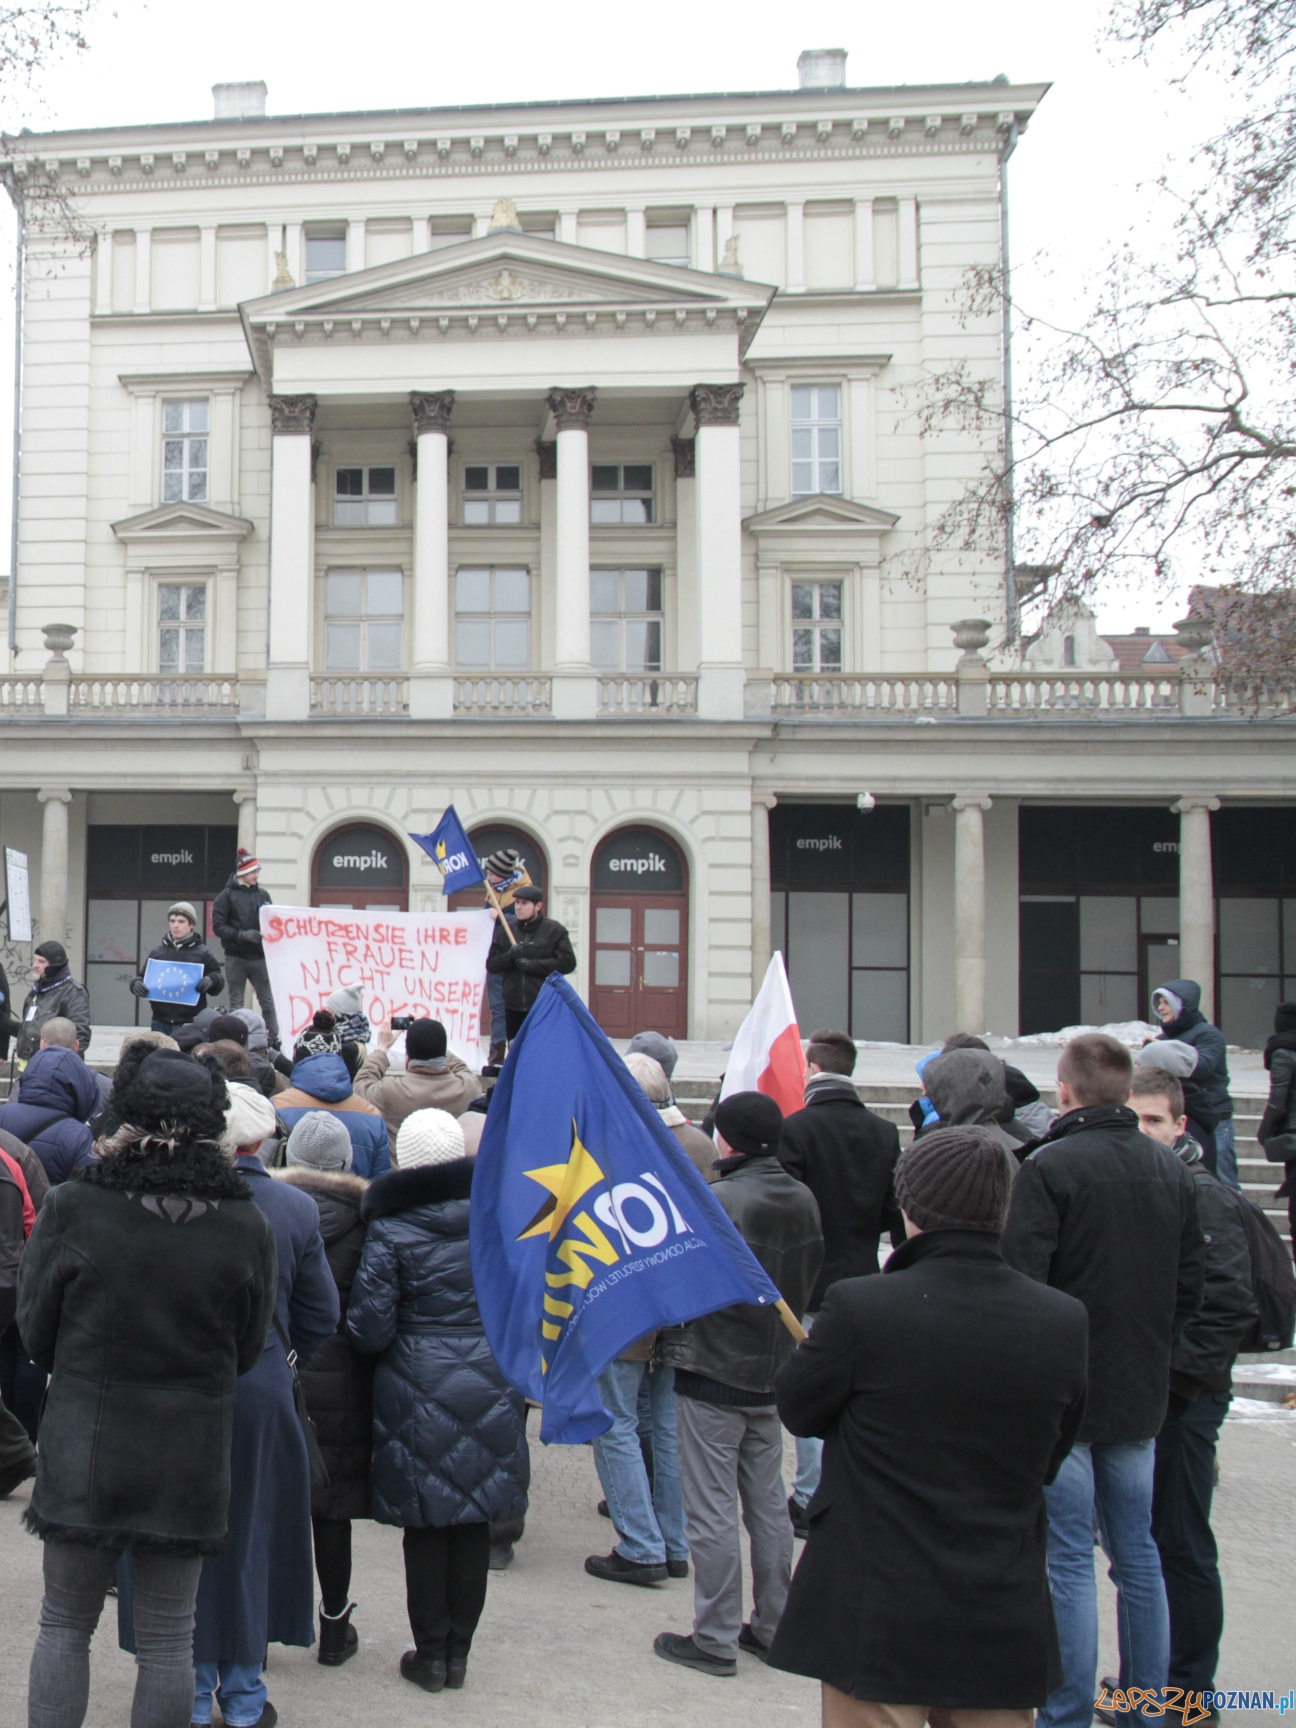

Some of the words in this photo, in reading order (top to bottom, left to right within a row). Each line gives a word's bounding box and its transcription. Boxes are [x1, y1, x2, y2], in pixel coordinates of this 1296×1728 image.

[796, 835, 842, 851] empik
[151, 849, 193, 865] empik
[333, 849, 388, 871] empik
[609, 852, 665, 875] empik
[417, 926, 468, 946] IHRE
[326, 940, 439, 973] FRAUEN
[300, 960, 391, 991] NICHT
[404, 975, 482, 1007] UNSERE
